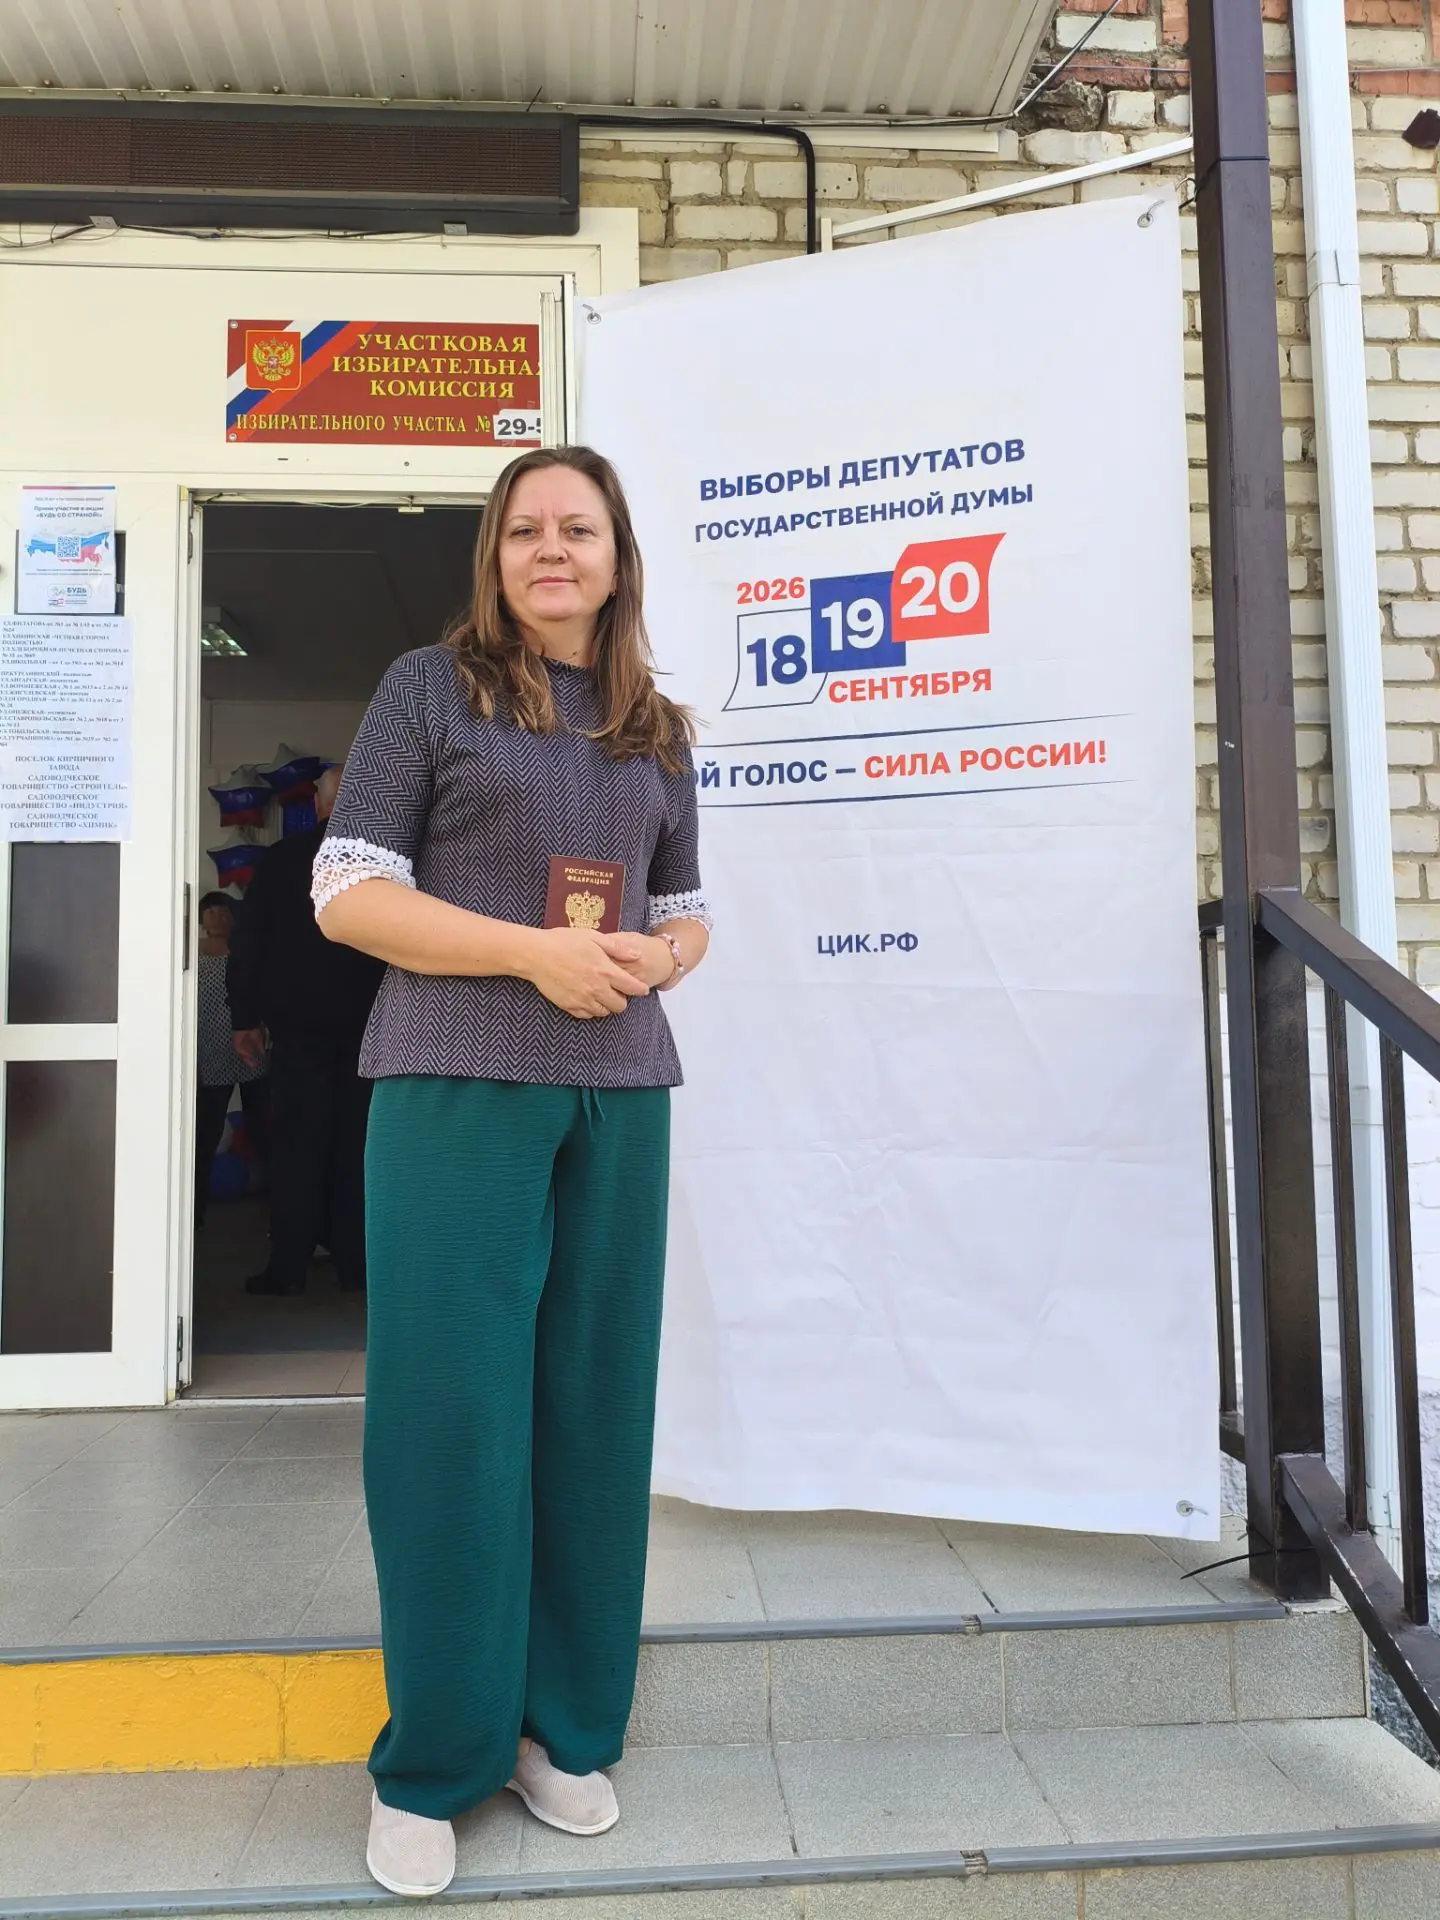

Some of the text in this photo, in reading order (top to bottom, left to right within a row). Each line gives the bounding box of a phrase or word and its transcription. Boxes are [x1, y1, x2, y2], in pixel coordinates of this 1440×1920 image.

[357, 334, 527, 353] УЧАСТКОВАЯ
[332, 356, 541, 376] ИЗБИРАТЕЛЬНА
[370, 379, 515, 398] КОМИССИЯ
[236, 413, 385, 431] ИЗБИРАТЕЛЬНОГО
[393, 415, 466, 433] УЧАСТКА
[475, 415, 490, 432] №
[700, 439, 1025, 501] ВЫБОРЫ ДЕПУТАТОВ
[695, 484, 1034, 543] ГОСУДАРСТВЕННОЙ ДУМЫ
[736, 577, 806, 605] 2026
[899, 561, 981, 619] 20
[820, 597, 885, 652] 19
[746, 635, 808, 687] 18
[828, 668, 992, 703] СЕНТЯБРЯ
[730, 759, 828, 788] ГОЛОС
[864, 749, 951, 779] СИЛА
[960, 740, 1107, 773] РОССИИ!
[565, 867, 614, 879] РОССИЙСКАЯ
[567, 875, 610, 885] ФЕДЕРАЦИЯ
[817, 932, 919, 957] ЦИК.РФ
